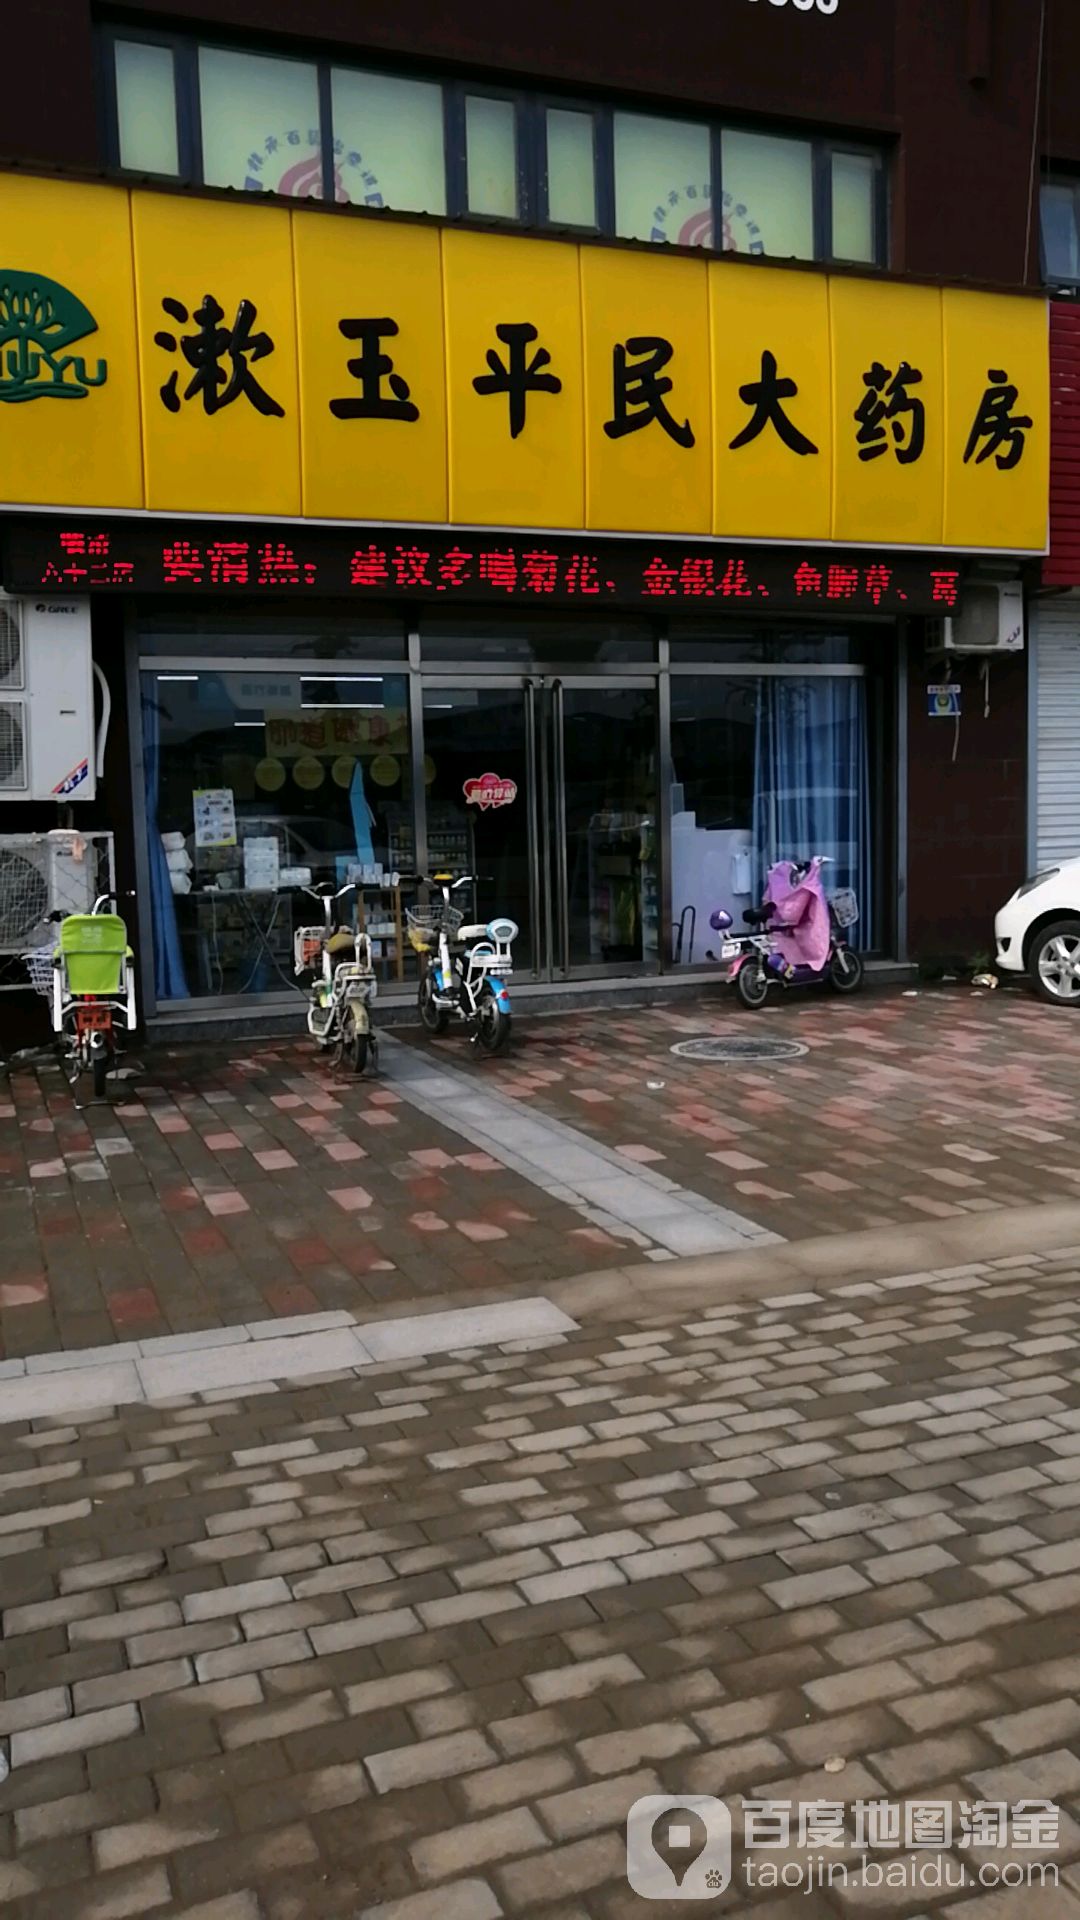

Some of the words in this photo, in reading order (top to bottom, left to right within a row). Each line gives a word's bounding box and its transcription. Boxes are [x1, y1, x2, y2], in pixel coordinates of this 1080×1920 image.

[154, 294, 1034, 470] 漱玉平民大药房
